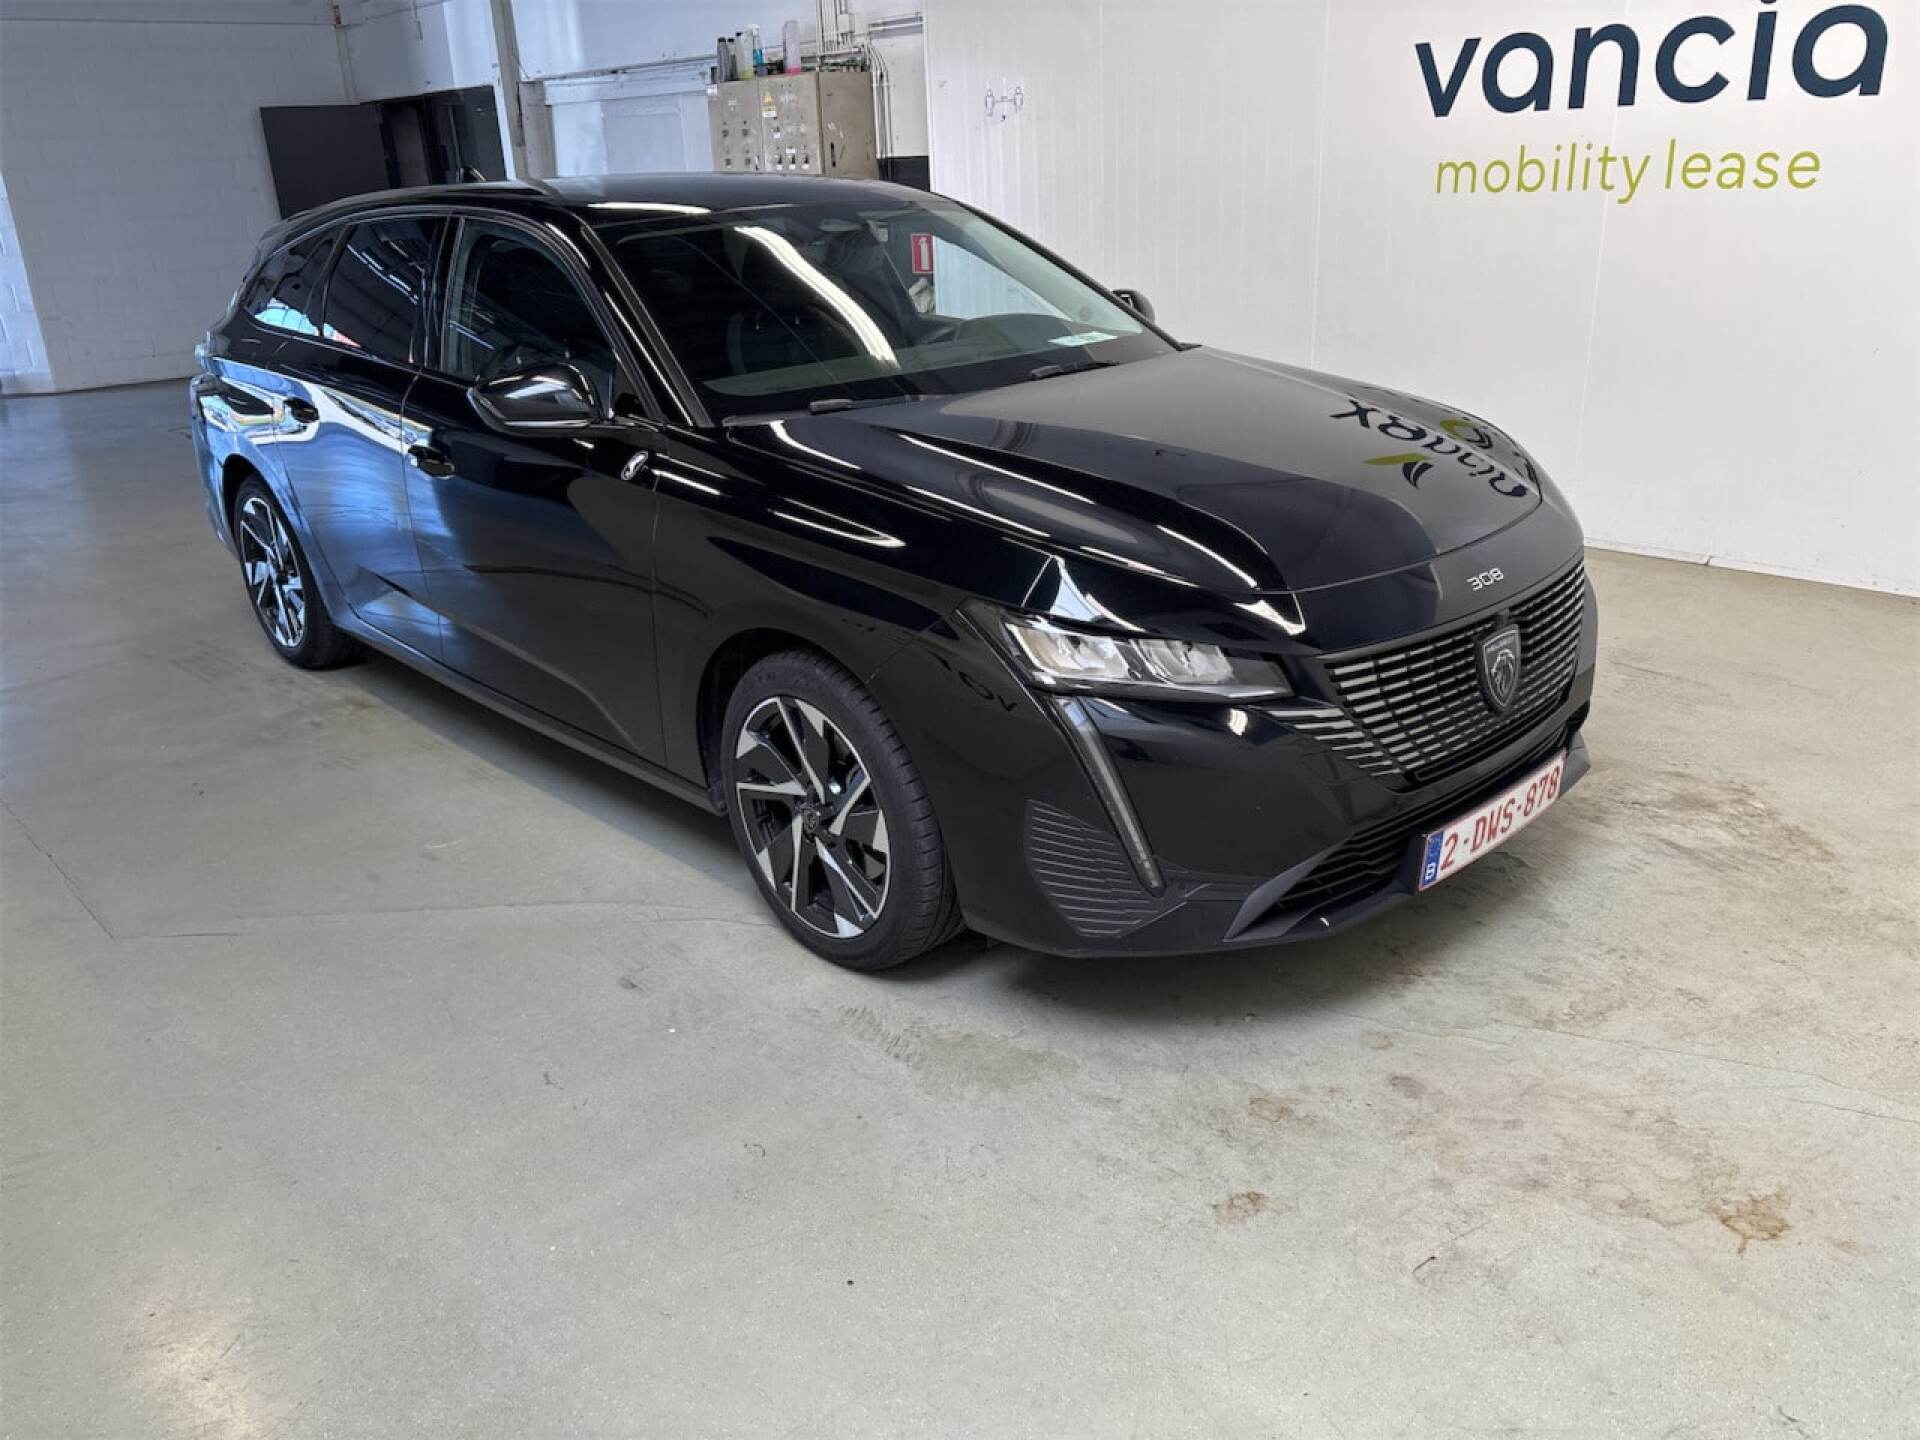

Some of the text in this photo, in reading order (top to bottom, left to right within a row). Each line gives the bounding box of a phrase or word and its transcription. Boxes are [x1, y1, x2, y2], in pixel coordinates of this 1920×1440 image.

[1415, 0, 1888, 117] vancia
[1436, 138, 1821, 204] mobility lease
[1466, 567, 1505, 592] 308
[1424, 862, 1437, 881] B
